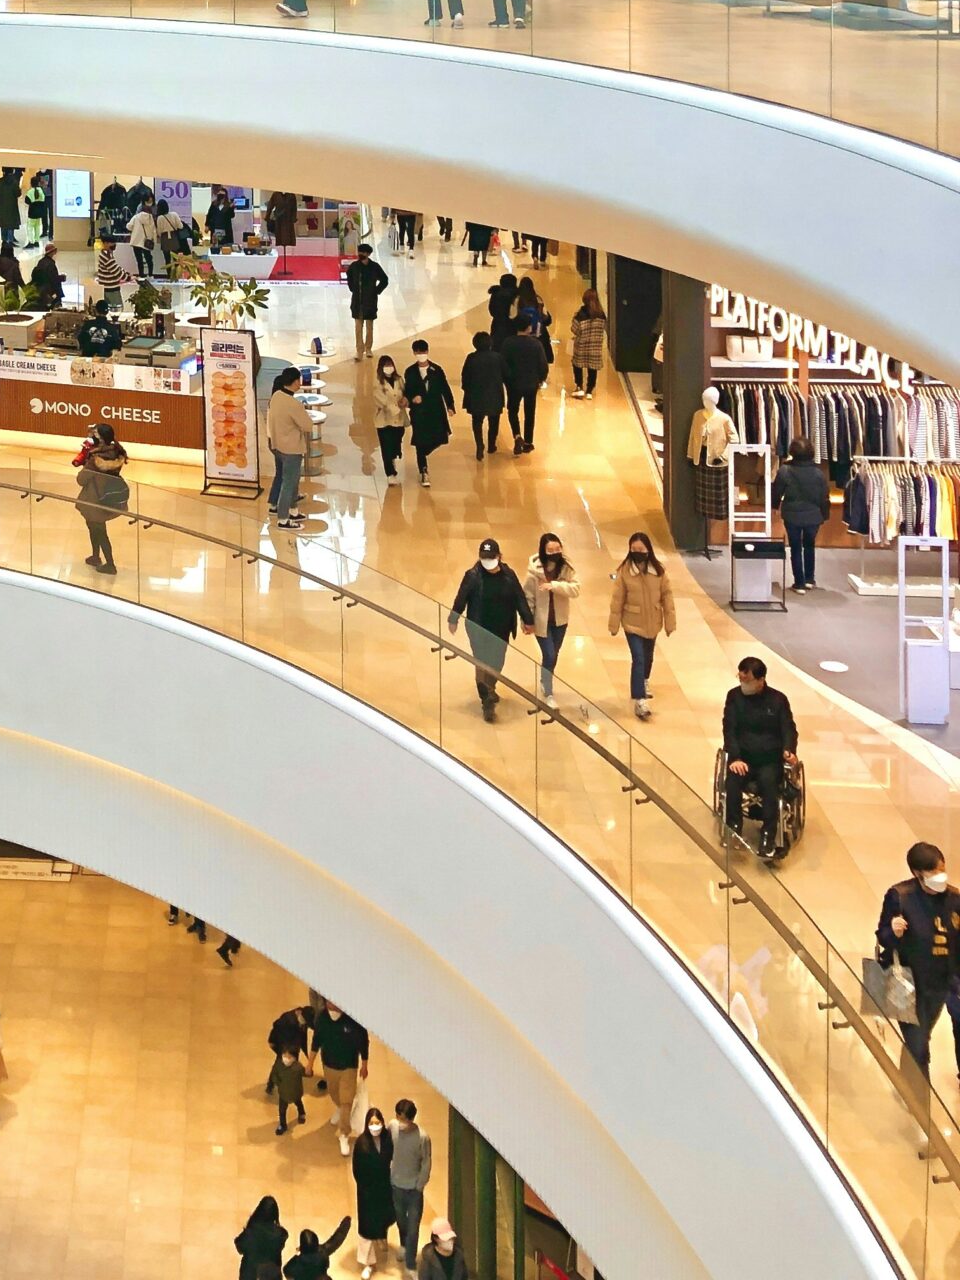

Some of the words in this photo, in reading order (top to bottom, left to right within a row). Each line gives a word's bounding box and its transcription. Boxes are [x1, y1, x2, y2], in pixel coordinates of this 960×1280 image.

[161, 181, 189, 199] 50
[709, 283, 828, 357] PLATFORM
[830, 330, 915, 396] PLACE
[16, 360, 36, 370] CREAM
[36, 362, 57, 372] CHEESE
[44, 400, 92, 417] MONO
[100, 405, 161, 424] CHEESE
